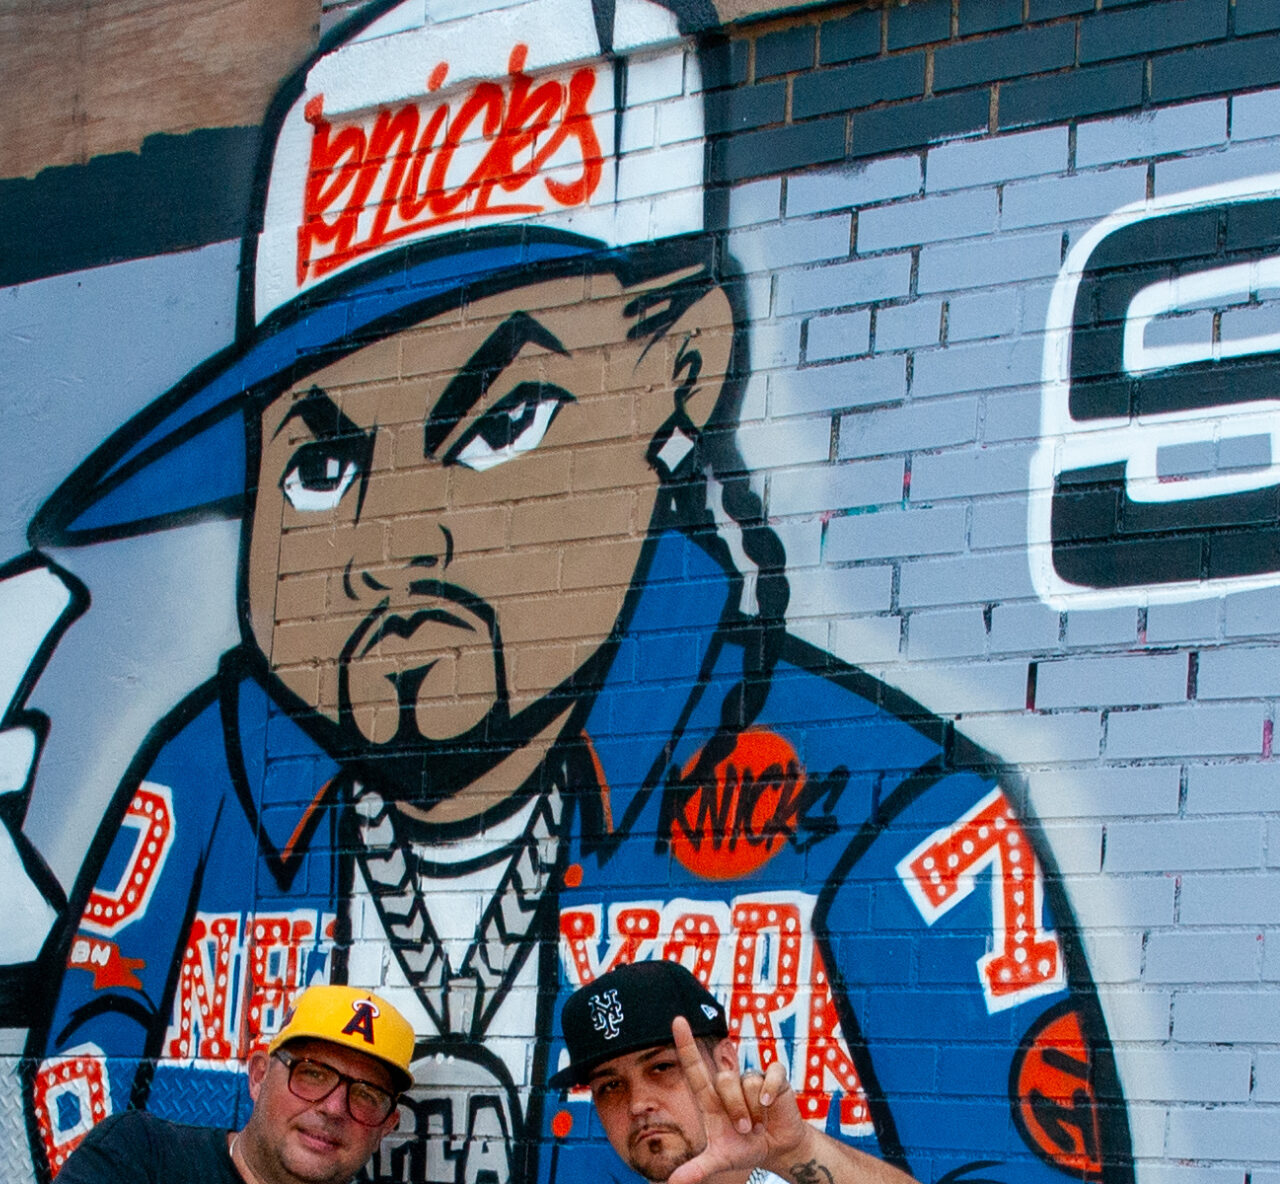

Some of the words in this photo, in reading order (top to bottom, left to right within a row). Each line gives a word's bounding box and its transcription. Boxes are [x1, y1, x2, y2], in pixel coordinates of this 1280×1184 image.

[654, 760, 850, 855] KNICKS
[160, 910, 340, 1072] NE
[341, 1000, 380, 1046] A
